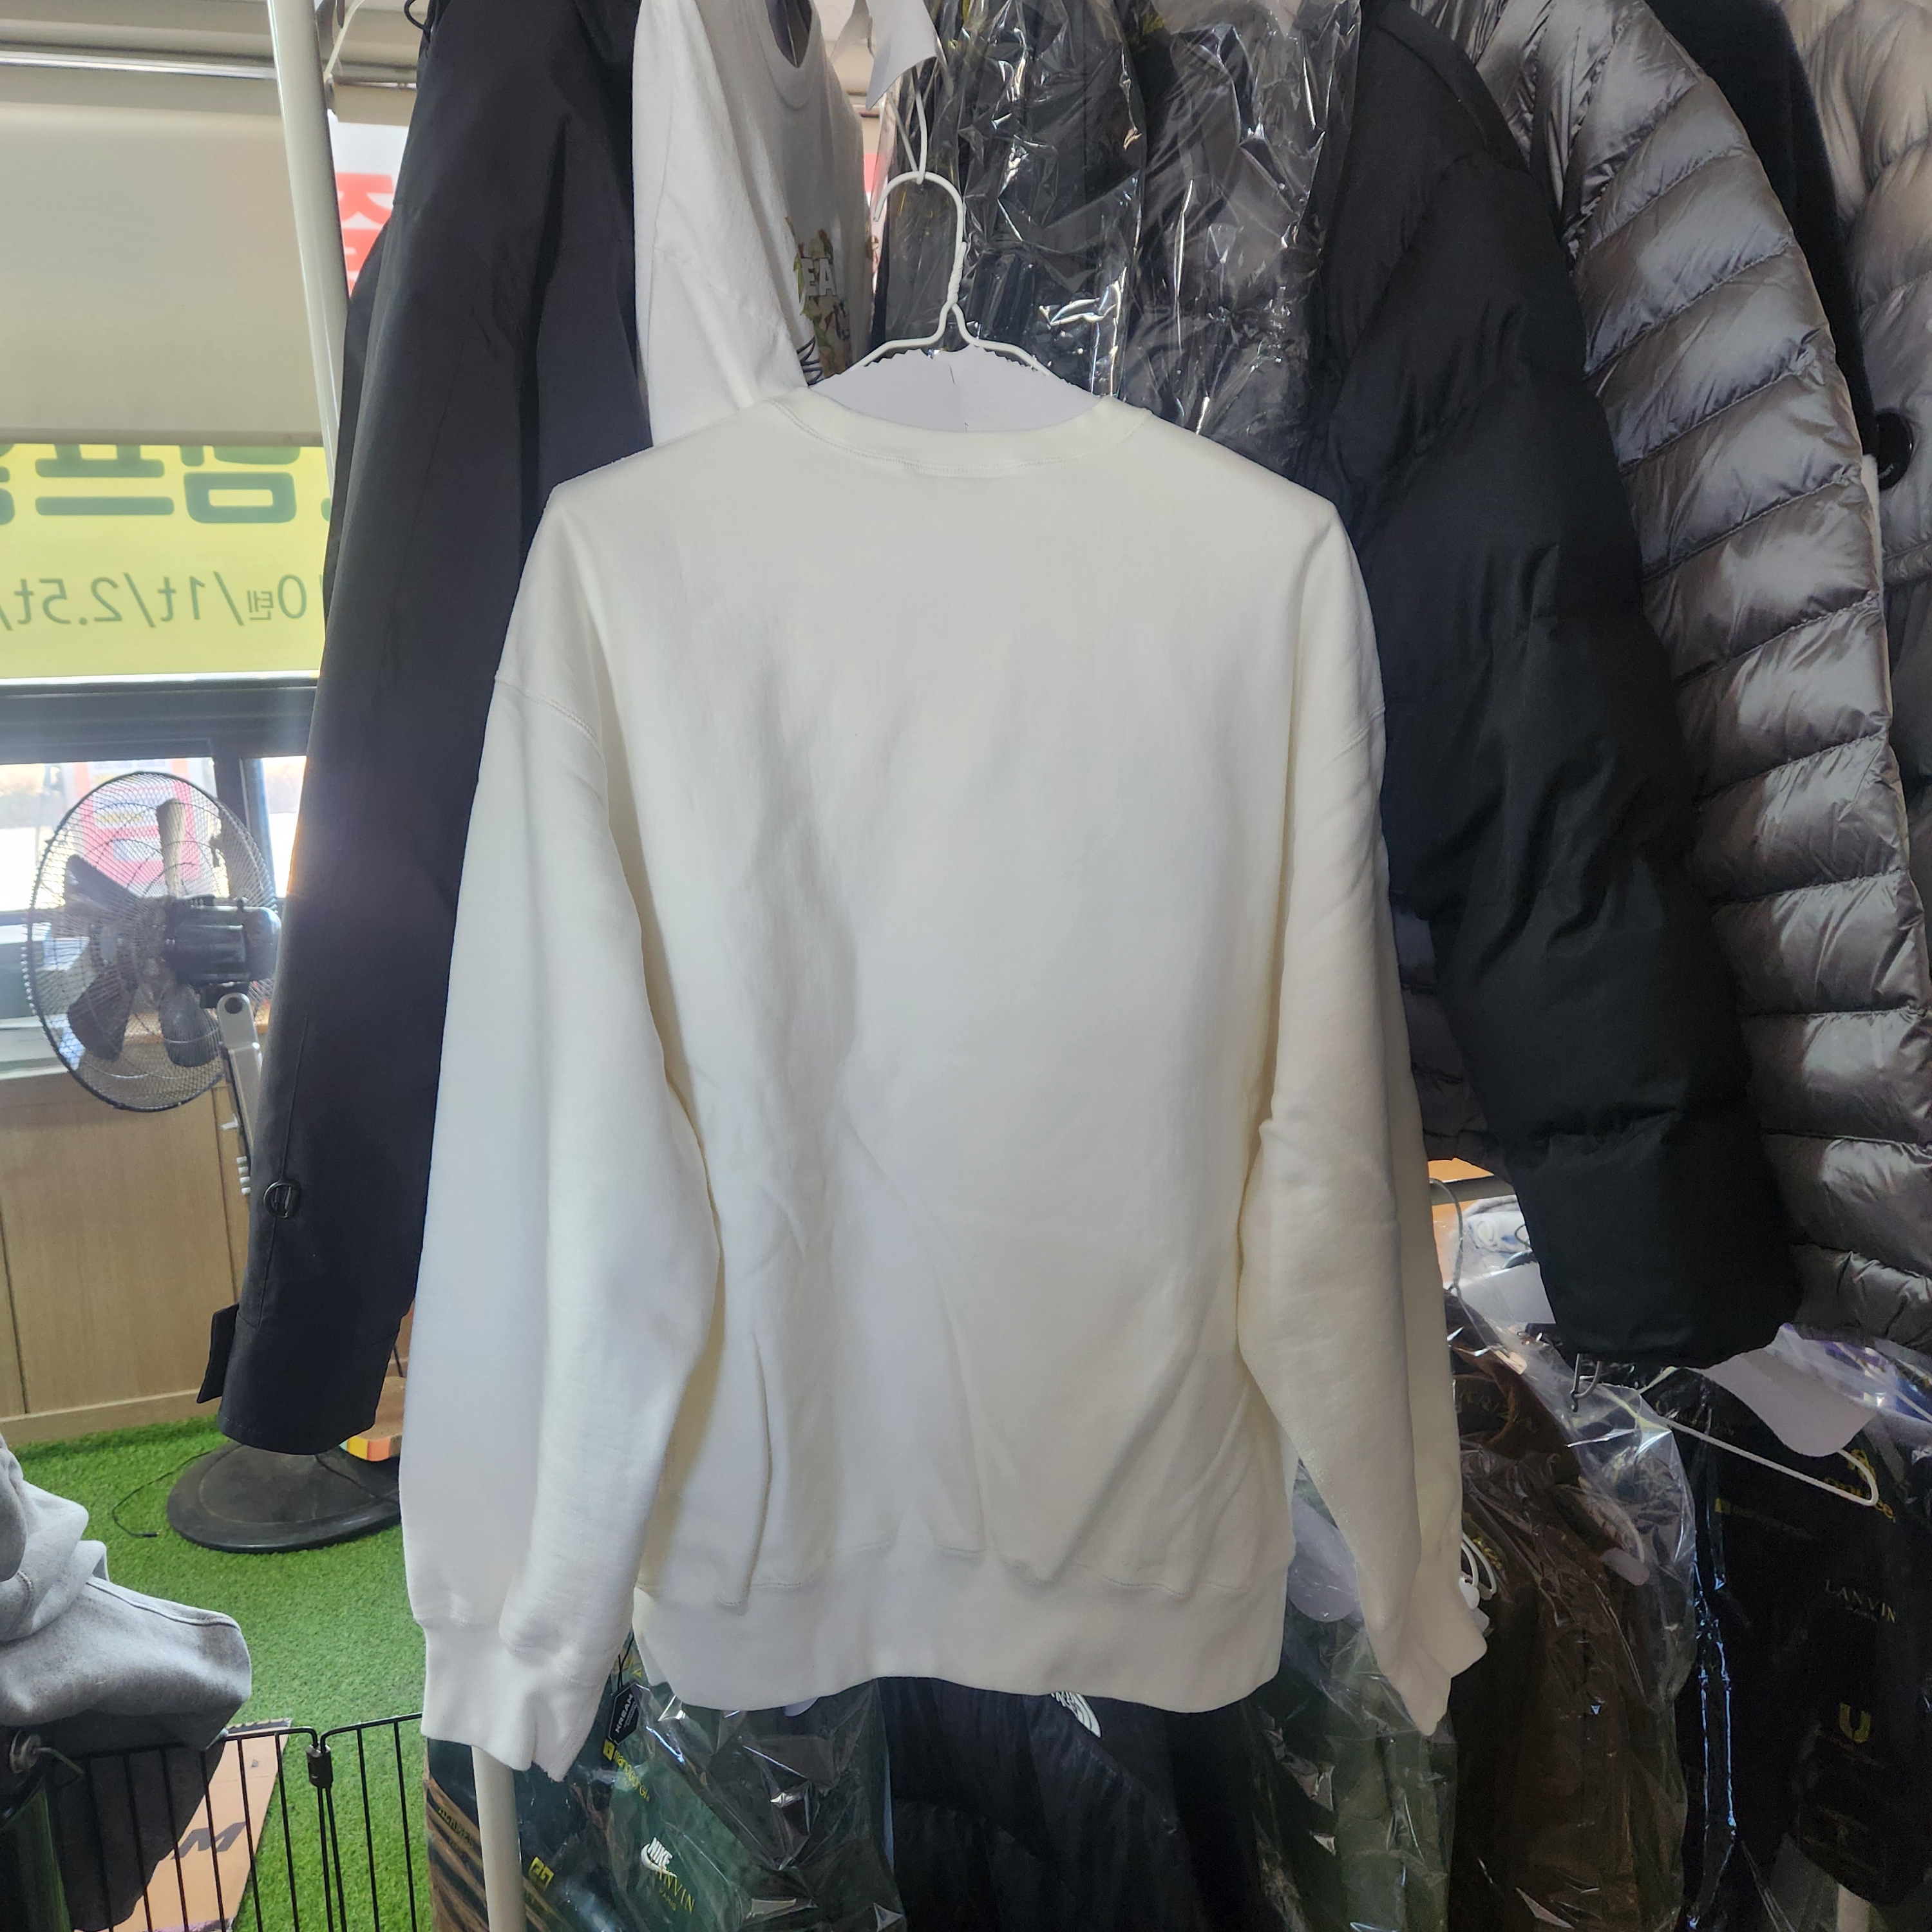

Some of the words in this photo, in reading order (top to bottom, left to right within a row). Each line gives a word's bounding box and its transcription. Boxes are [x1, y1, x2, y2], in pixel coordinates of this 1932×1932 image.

[1824, 1578, 1897, 1624] LANVIN
[614, 1693, 634, 1734] KREAM
[647, 1837, 673, 1870] NIKE
